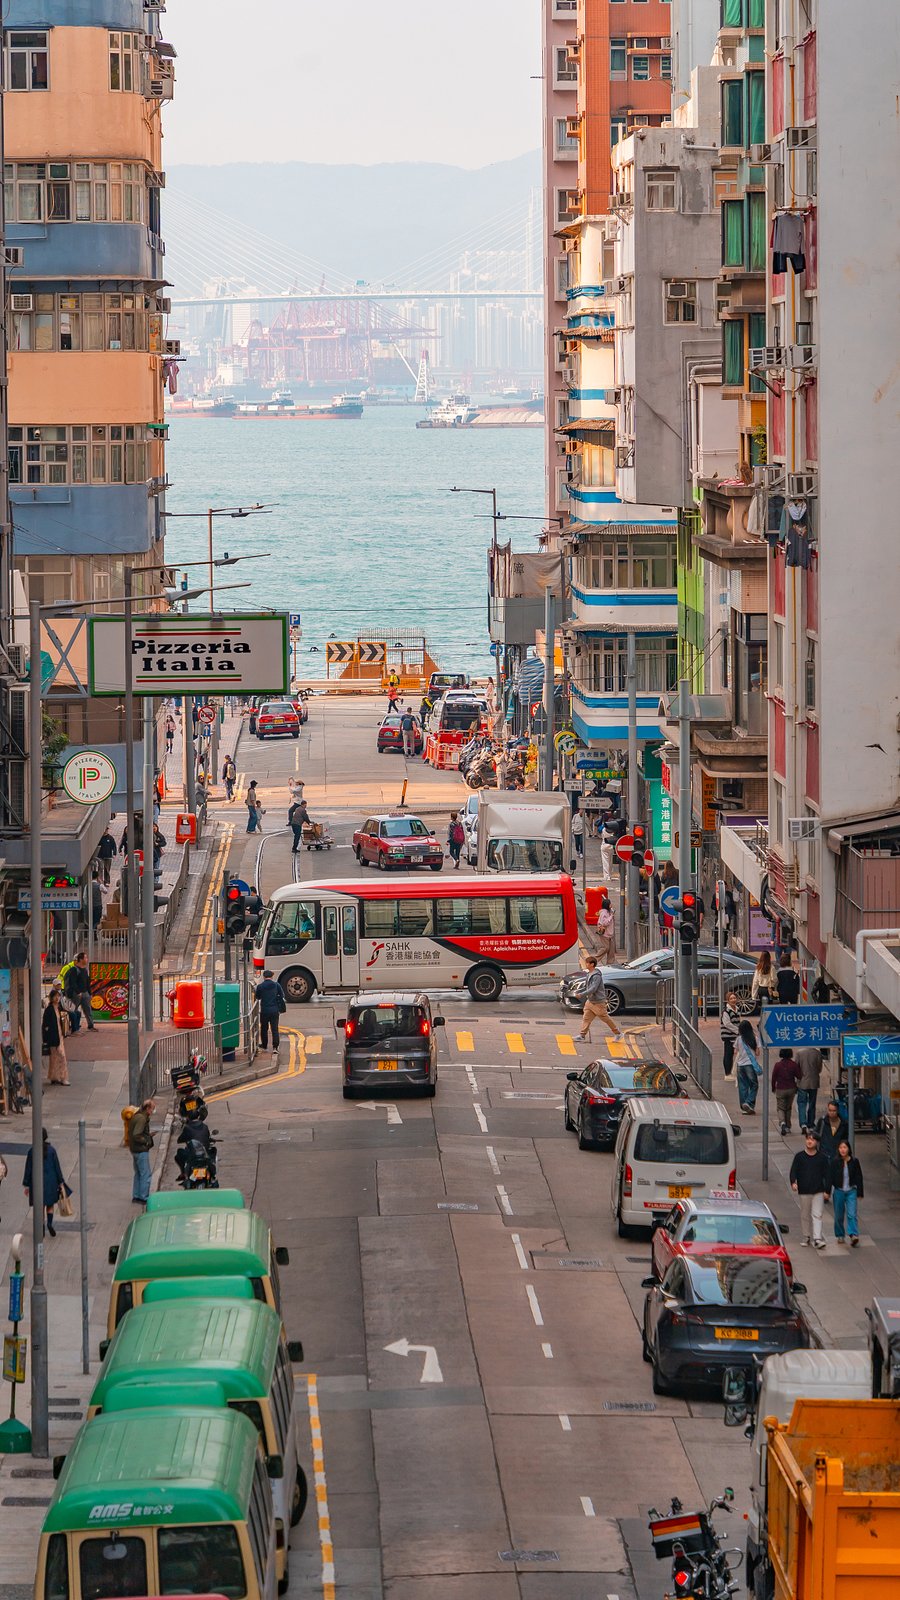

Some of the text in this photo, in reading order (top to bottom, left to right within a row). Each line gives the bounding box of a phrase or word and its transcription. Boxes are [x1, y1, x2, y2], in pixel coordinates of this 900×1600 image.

[131, 639, 252, 655] Pizzeria
[142, 656, 236, 672] Italia
[661, 797, 671, 843] 香港置業
[385, 942, 410, 951] SAHK
[775, 1012, 851, 1022] Victoria Roa
[776, 1027, 840, 1041] 域多利道
[846, 1051, 871, 1066] 洗衣
[712, 1191, 740, 1199] TAXI
[89, 1503, 134, 1519] AMS
